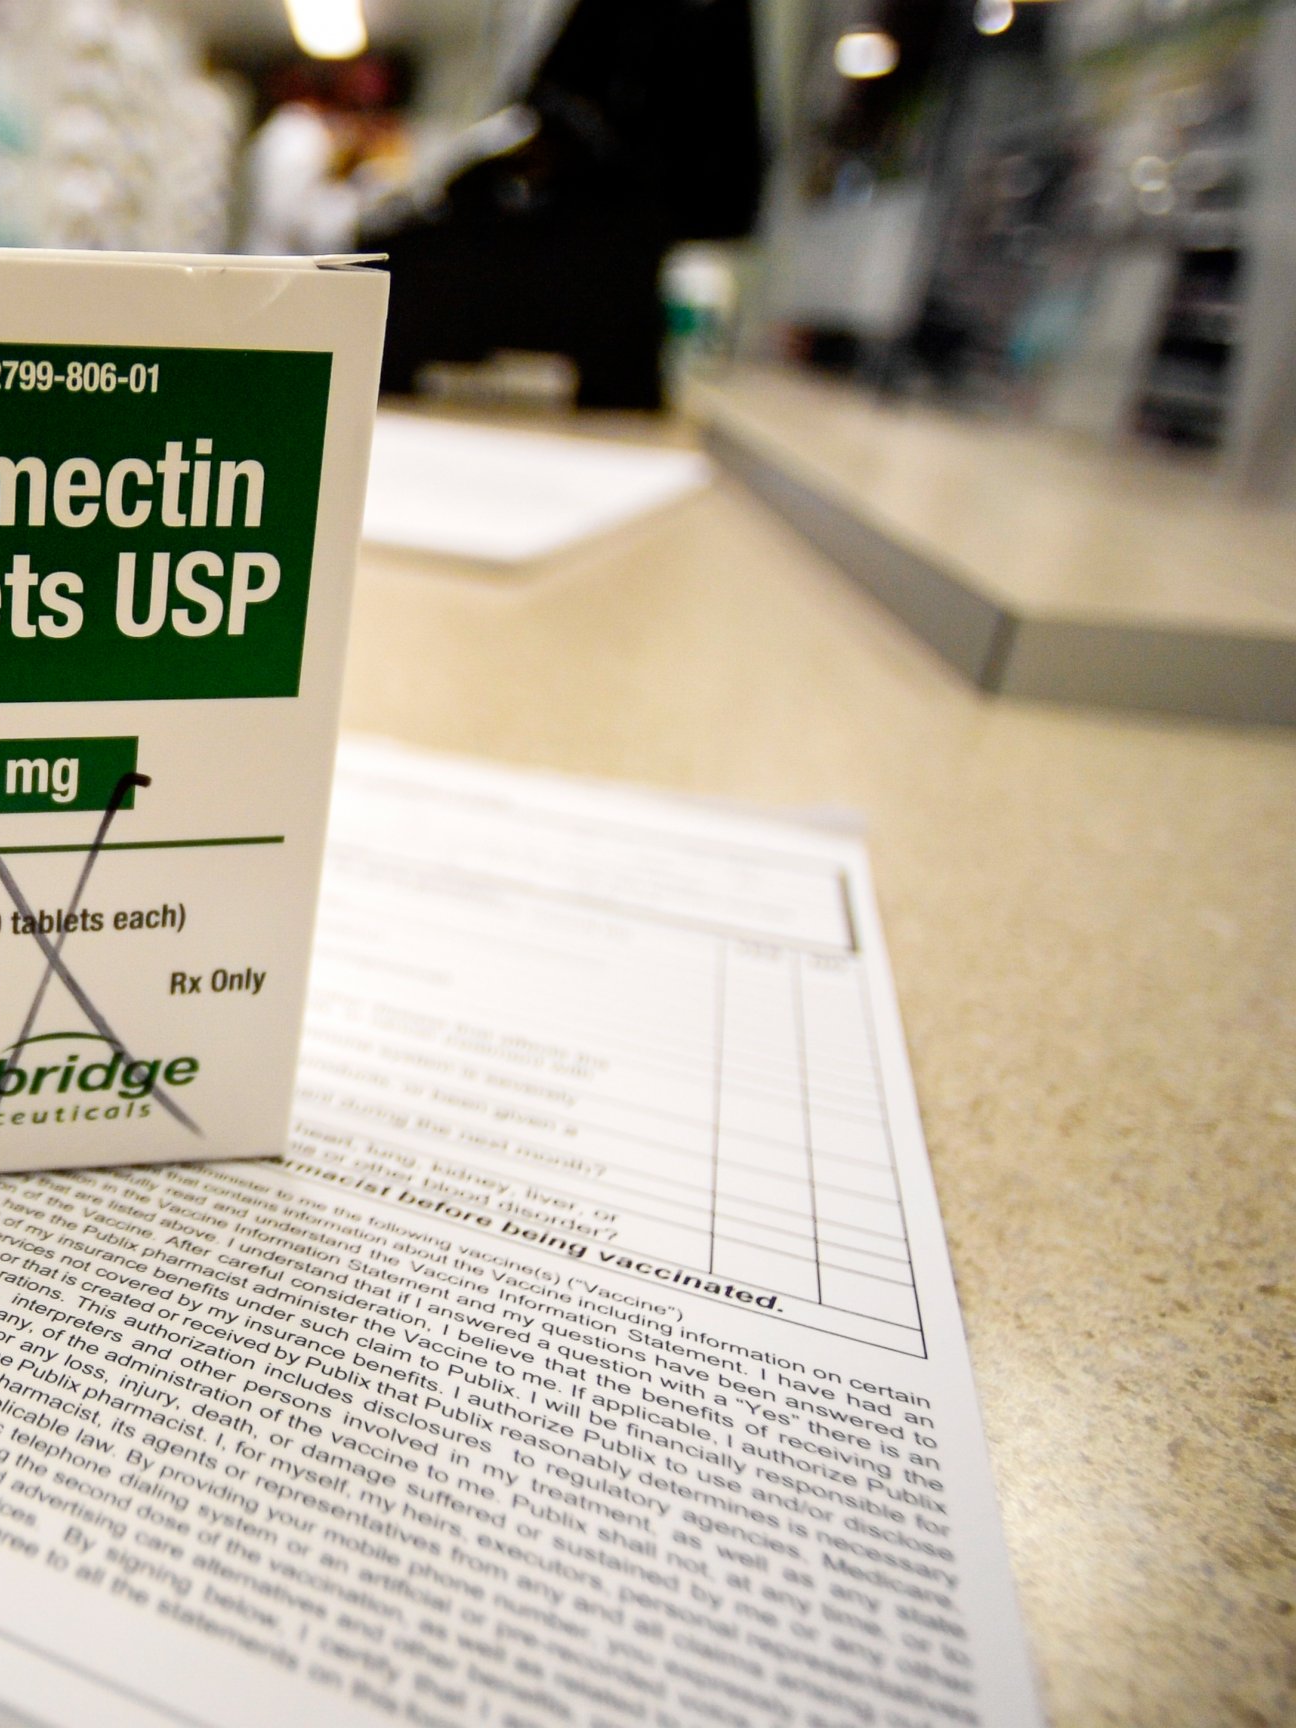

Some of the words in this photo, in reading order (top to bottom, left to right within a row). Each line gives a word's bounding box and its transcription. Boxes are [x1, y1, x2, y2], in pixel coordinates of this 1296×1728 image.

[116, 550, 281, 638] USP
[6, 754, 80, 804] mg
[11, 906, 104, 934] tablets
[113, 903, 186, 932] each)
[169, 971, 201, 995] Rx
[211, 967, 267, 996] Only
[282, 1206, 388, 1246] information
[391, 1241, 448, 1265] about
[453, 1258, 485, 1276] the
[491, 1268, 572, 1304] Vaccine
[577, 1296, 673, 1337] including
[680, 1325, 806, 1374] information
[812, 1367, 842, 1385] on
[848, 1378, 931, 1410] certain
[397, 1188, 493, 1228] before
[500, 1220, 588, 1260] being
[598, 1249, 785, 1313] vaccinated.
[10, 1294, 124, 1343] interpreters
[130, 1339, 173, 1361] and
[179, 1356, 237, 1383] other
[242, 1379, 332, 1419] persons
[342, 1410, 439, 1457] involved
[449, 1448, 470, 1469] in
[481, 1463, 519, 1487] my
[94, 1267, 175, 1301] covered
[176, 1292, 204, 1312] by
[206, 1305, 240, 1325] my
[243, 1318, 346, 1360] insurance
[351, 1351, 443, 1395] benefits.
[140, 1246, 249, 1289] pharmacist
[251, 1283, 359, 1324] administer
[362, 1317, 396, 1338] the
[403, 1328, 488, 1368] Vaccine
[494, 1359, 515, 1377] to
[521, 1370, 562, 1393] me.
[571, 1383, 587, 1400] If
[591, 1394, 718, 1446] applicable,
[741, 1441, 858, 1487] authorize
[865, 1476, 947, 1516] Publix
[233, 1222, 341, 1265] Information
[347, 1258, 450, 1300] Statement
[455, 1294, 496, 1314] and
[502, 1308, 535, 1328] my
[540, 1321, 647, 1362] questions
[654, 1353, 710, 1382] have
[718, 1373, 776, 1403] been
[784, 1396, 905, 1440] answered
[913, 1430, 938, 1449] to
[238, 1243, 349, 1285] understand
[353, 1277, 391, 1299] that
[396, 1291, 412, 1305] if
[426, 1303, 531, 1344] answered
[536, 1338, 550, 1351] a
[556, 1344, 652, 1383] question
[659, 1376, 705, 1400] with
[713, 1393, 727, 1407] a
[807, 1419, 872, 1450] there
[879, 1443, 900, 1459] is
[908, 1452, 940, 1471] an
[16, 1358, 81, 1393] Publix
[81, 1386, 206, 1442] pharmacist.
